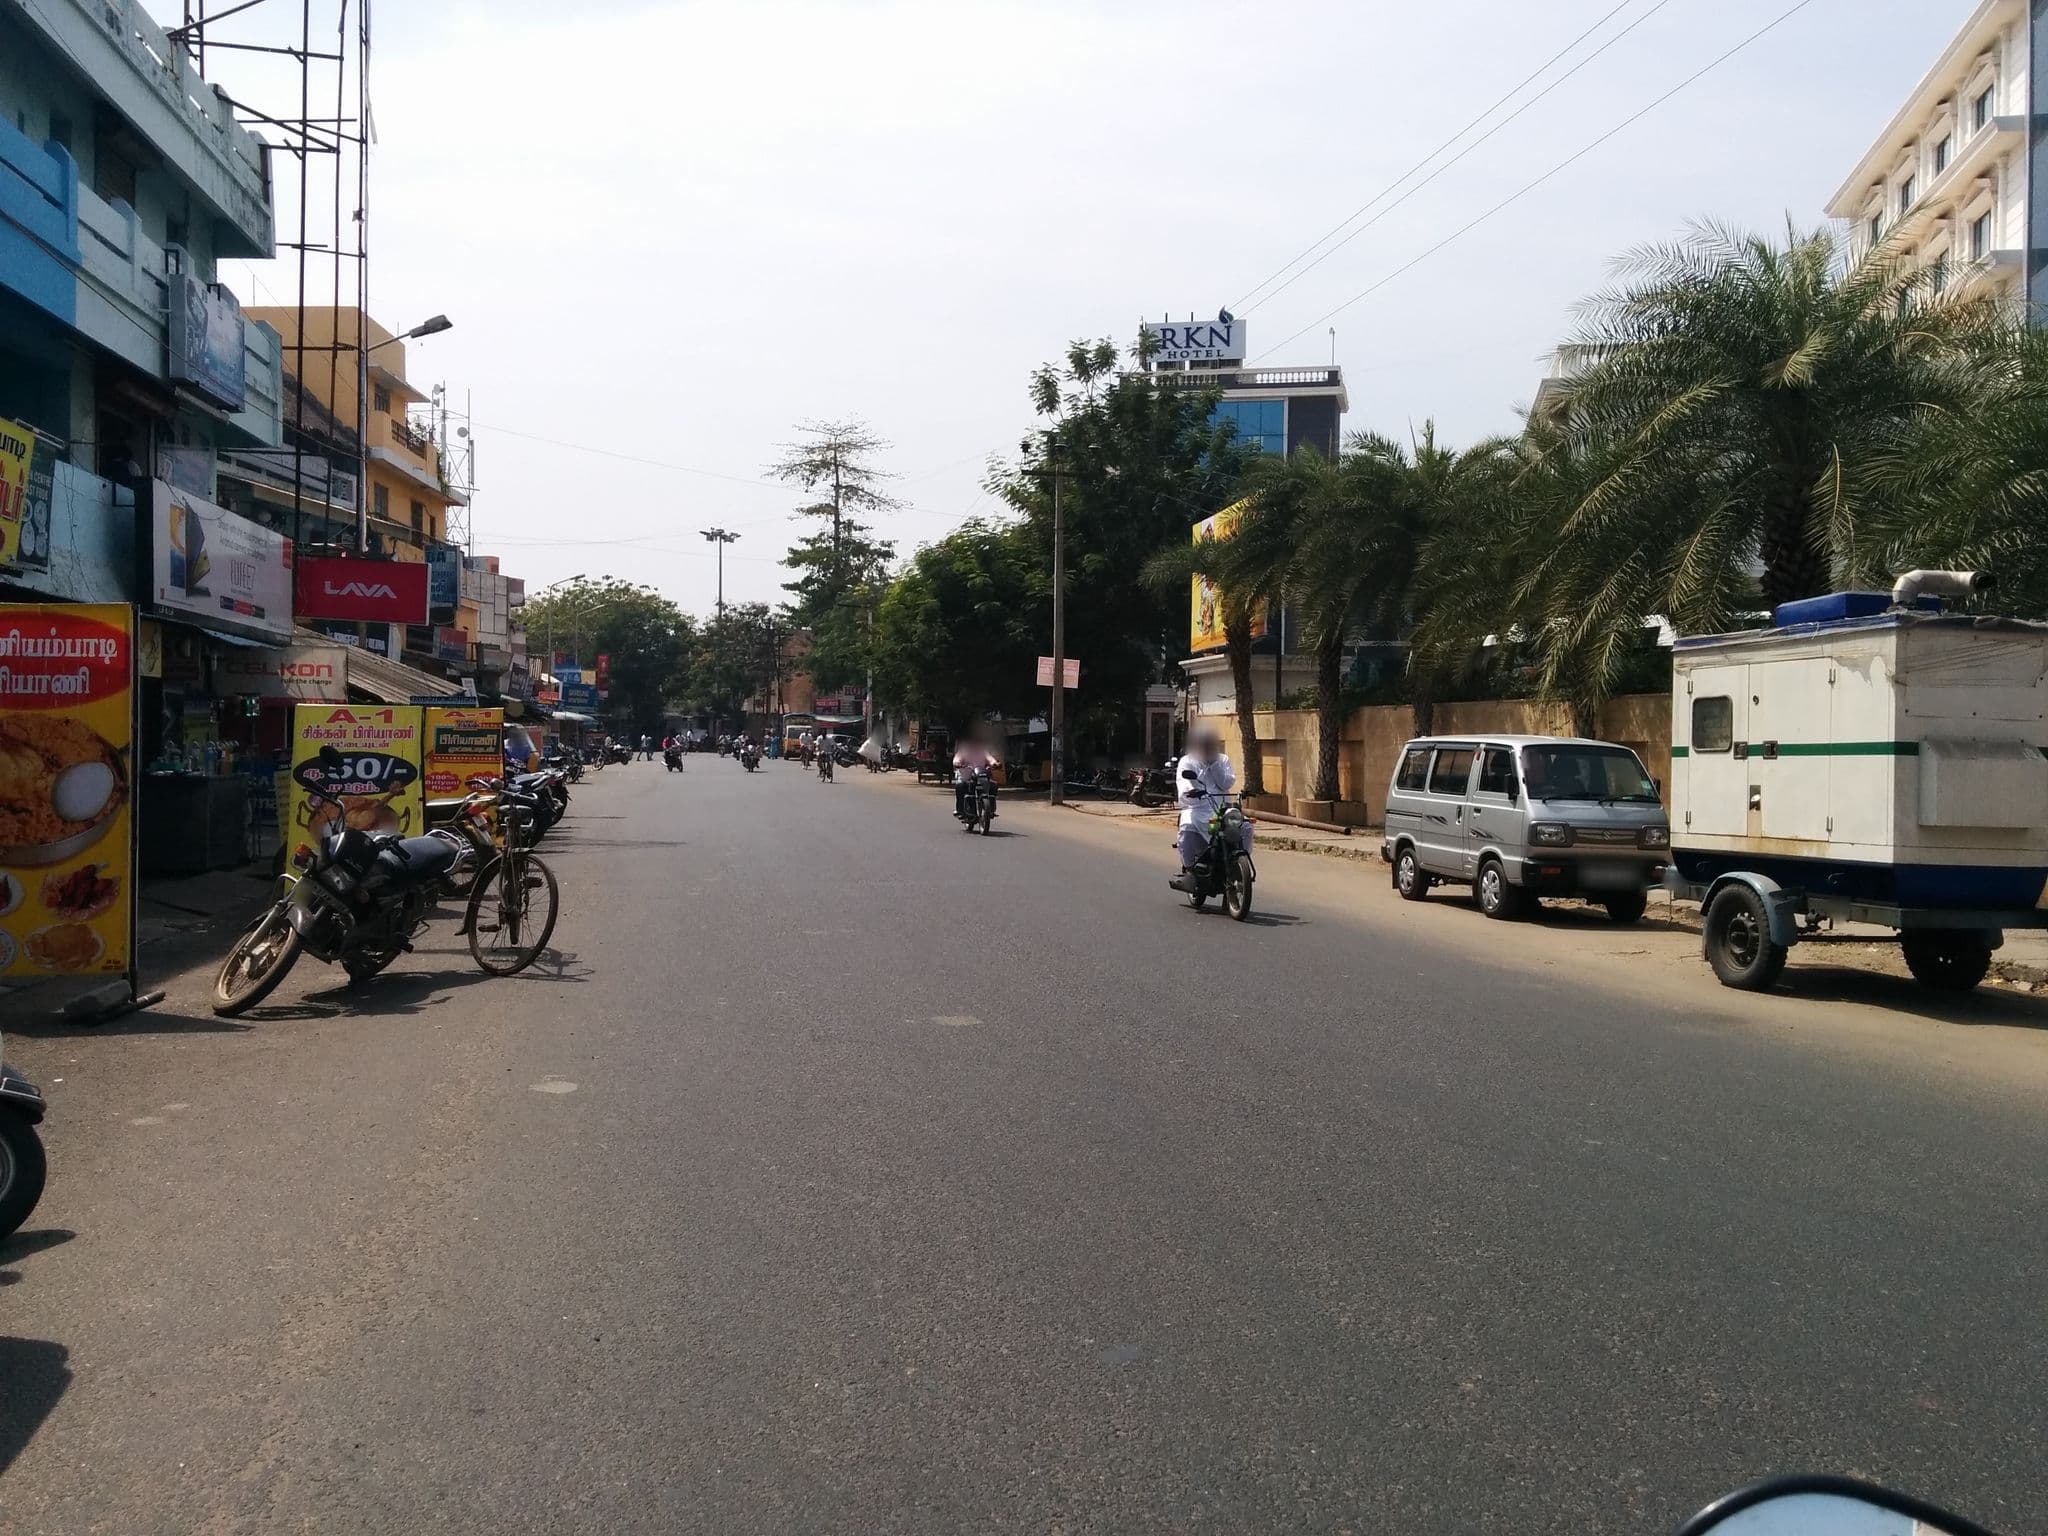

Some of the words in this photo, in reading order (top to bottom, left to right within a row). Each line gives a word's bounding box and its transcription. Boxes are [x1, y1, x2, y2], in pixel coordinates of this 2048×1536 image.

[1160, 325, 1233, 350] RKN
[1167, 350, 1225, 359] HOTEL
[324, 580, 397, 599] LAVA
[326, 708, 394, 724] A-1
[302, 725, 348, 739] சிக்கன்
[353, 725, 414, 741] பிரியாணி
